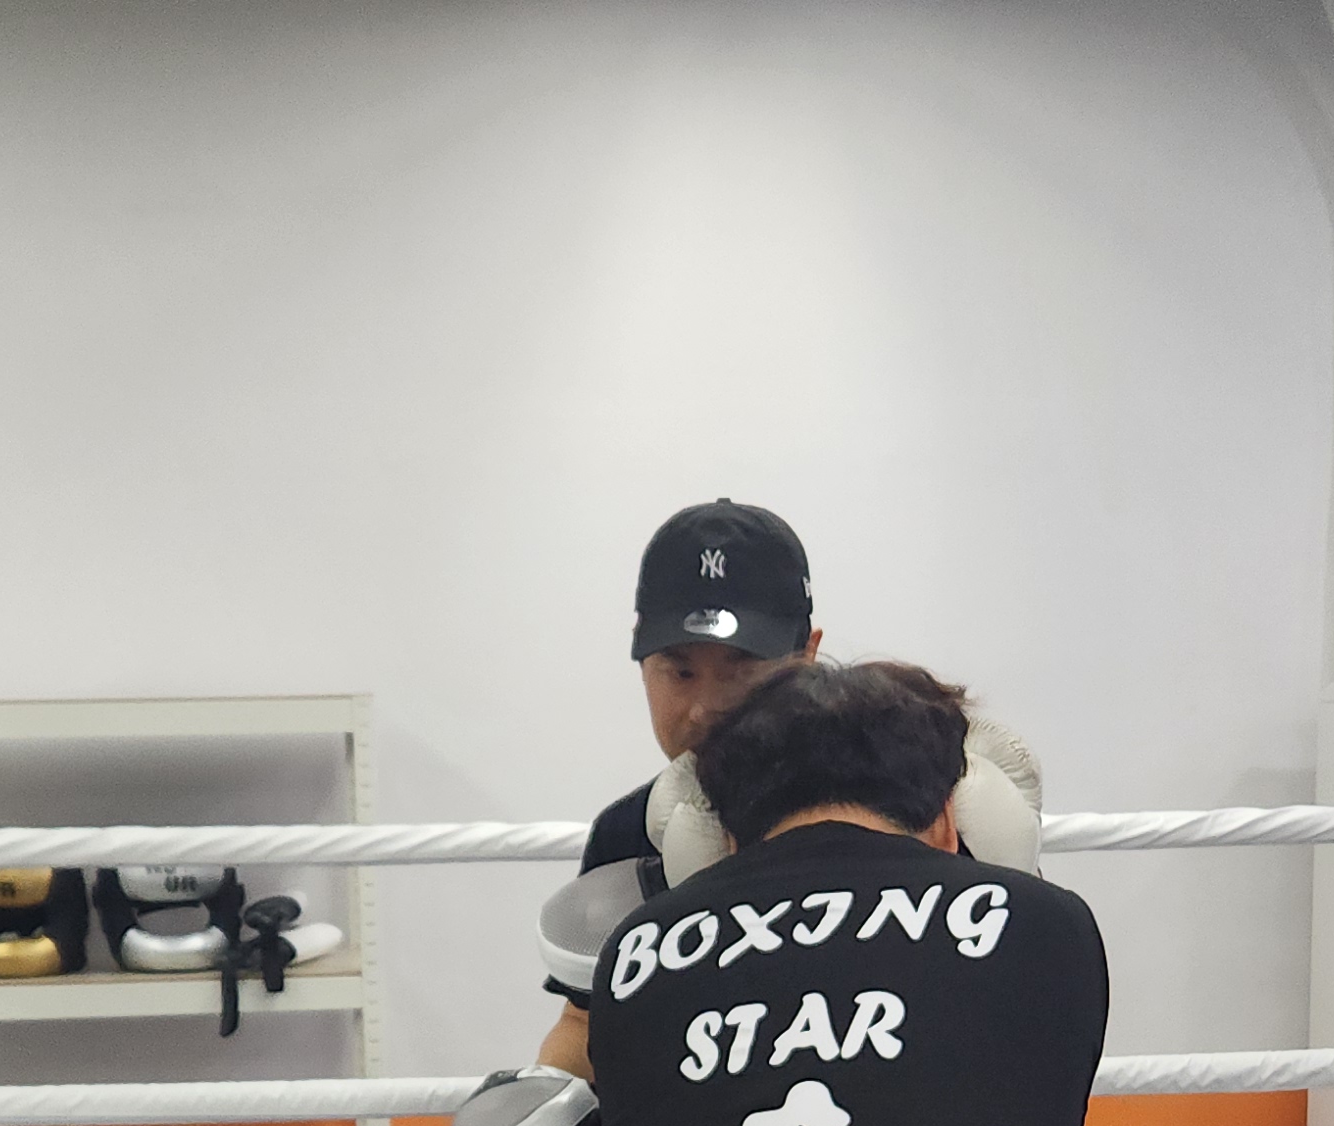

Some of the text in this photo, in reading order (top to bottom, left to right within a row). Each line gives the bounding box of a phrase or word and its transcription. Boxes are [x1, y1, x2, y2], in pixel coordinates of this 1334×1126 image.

[699, 549, 725, 578] NY
[611, 884, 1009, 1000] BOXING
[680, 990, 905, 1081] STAR
